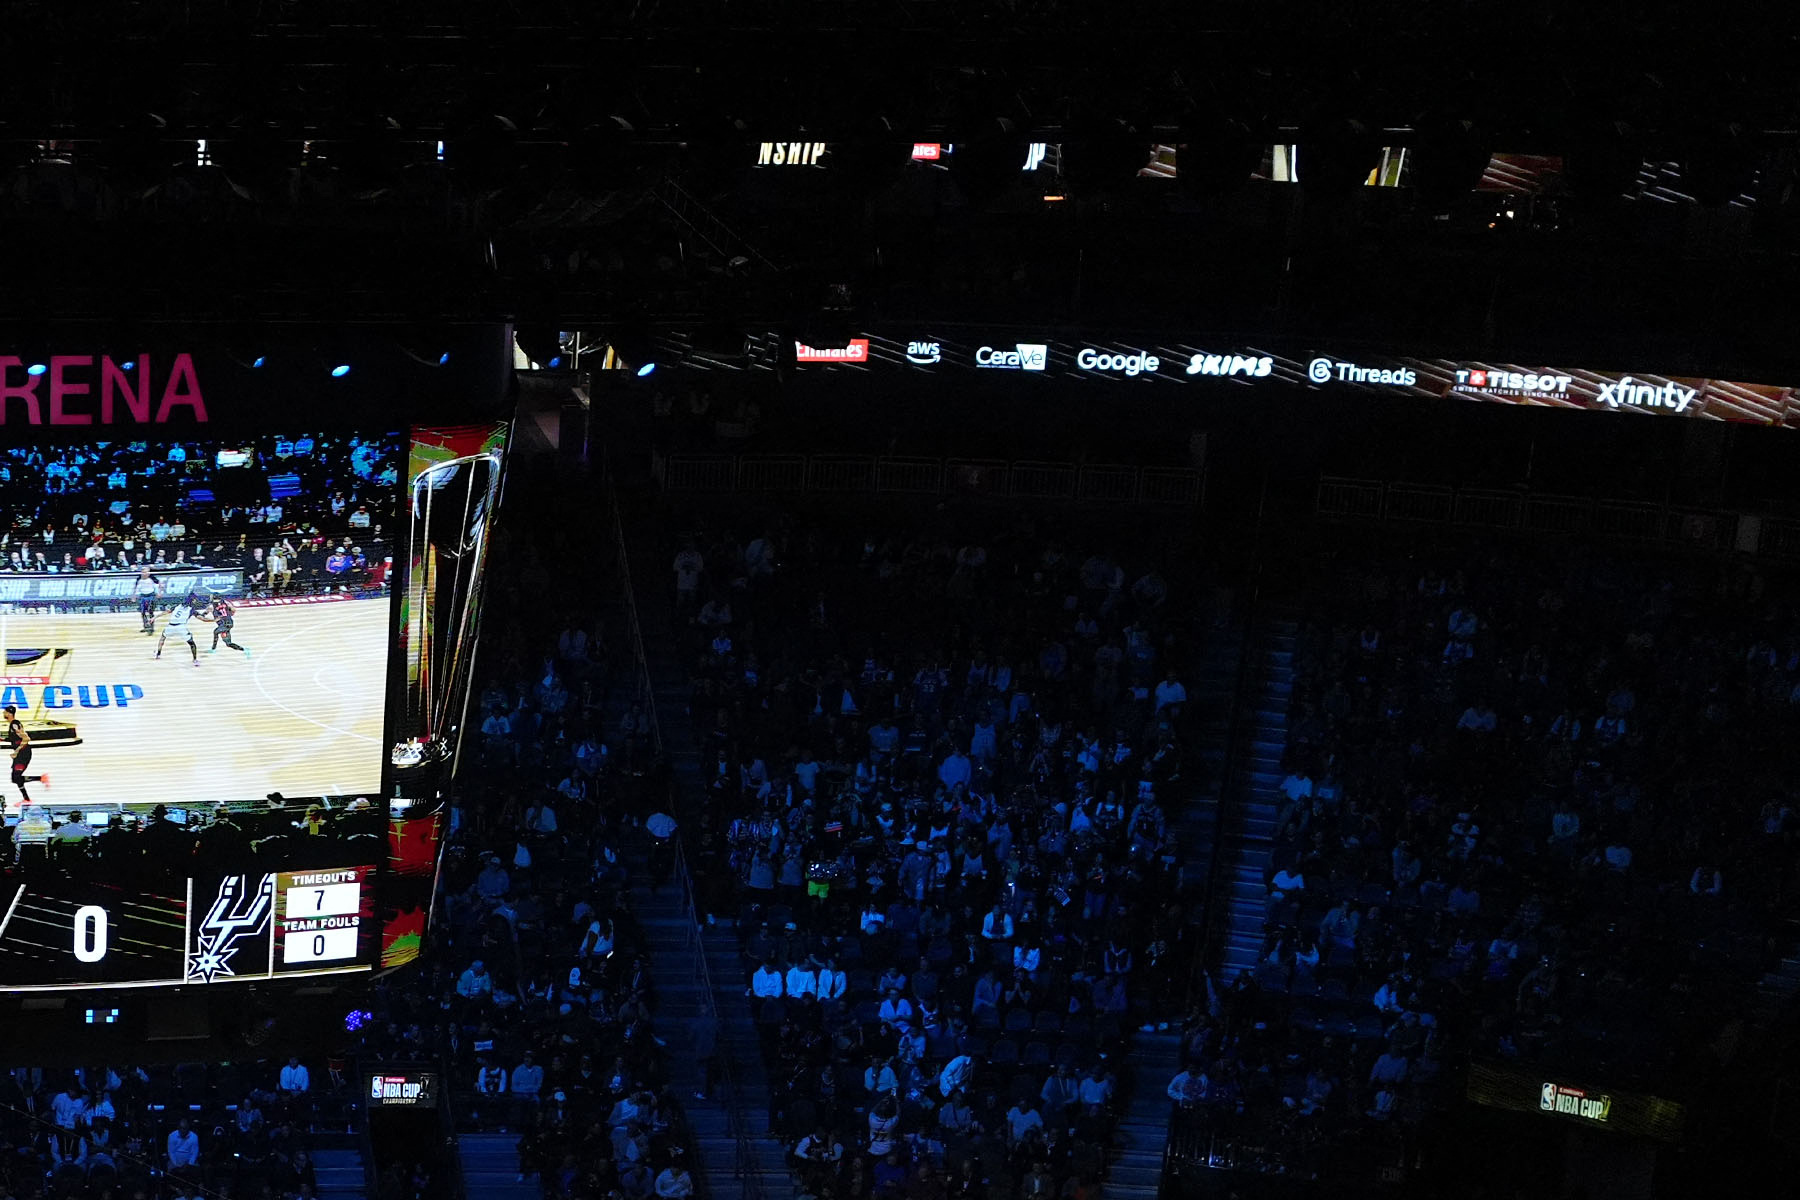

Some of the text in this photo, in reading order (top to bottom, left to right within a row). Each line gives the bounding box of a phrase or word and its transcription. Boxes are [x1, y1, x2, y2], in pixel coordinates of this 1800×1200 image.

[907, 341, 940, 356] aws
[976, 346, 1043, 368] CeraVe
[1077, 349, 1159, 375] Google
[1187, 353, 1272, 377] SKIMS
[1336, 363, 1416, 385] Threads
[1487, 371, 1572, 392] TISSOT
[1597, 376, 1695, 412] xfinity
[44, 684, 144, 709] CUP
[292, 871, 356, 886] TIMEOUTS
[313, 889, 324, 911] 7
[73, 905, 108, 962] 0
[283, 915, 360, 931] TEAM FOULS
[313, 934, 325, 956] 0
[383, 1083, 420, 1098] NBA CUP
[1556, 1094, 1604, 1120] NBA CUP
